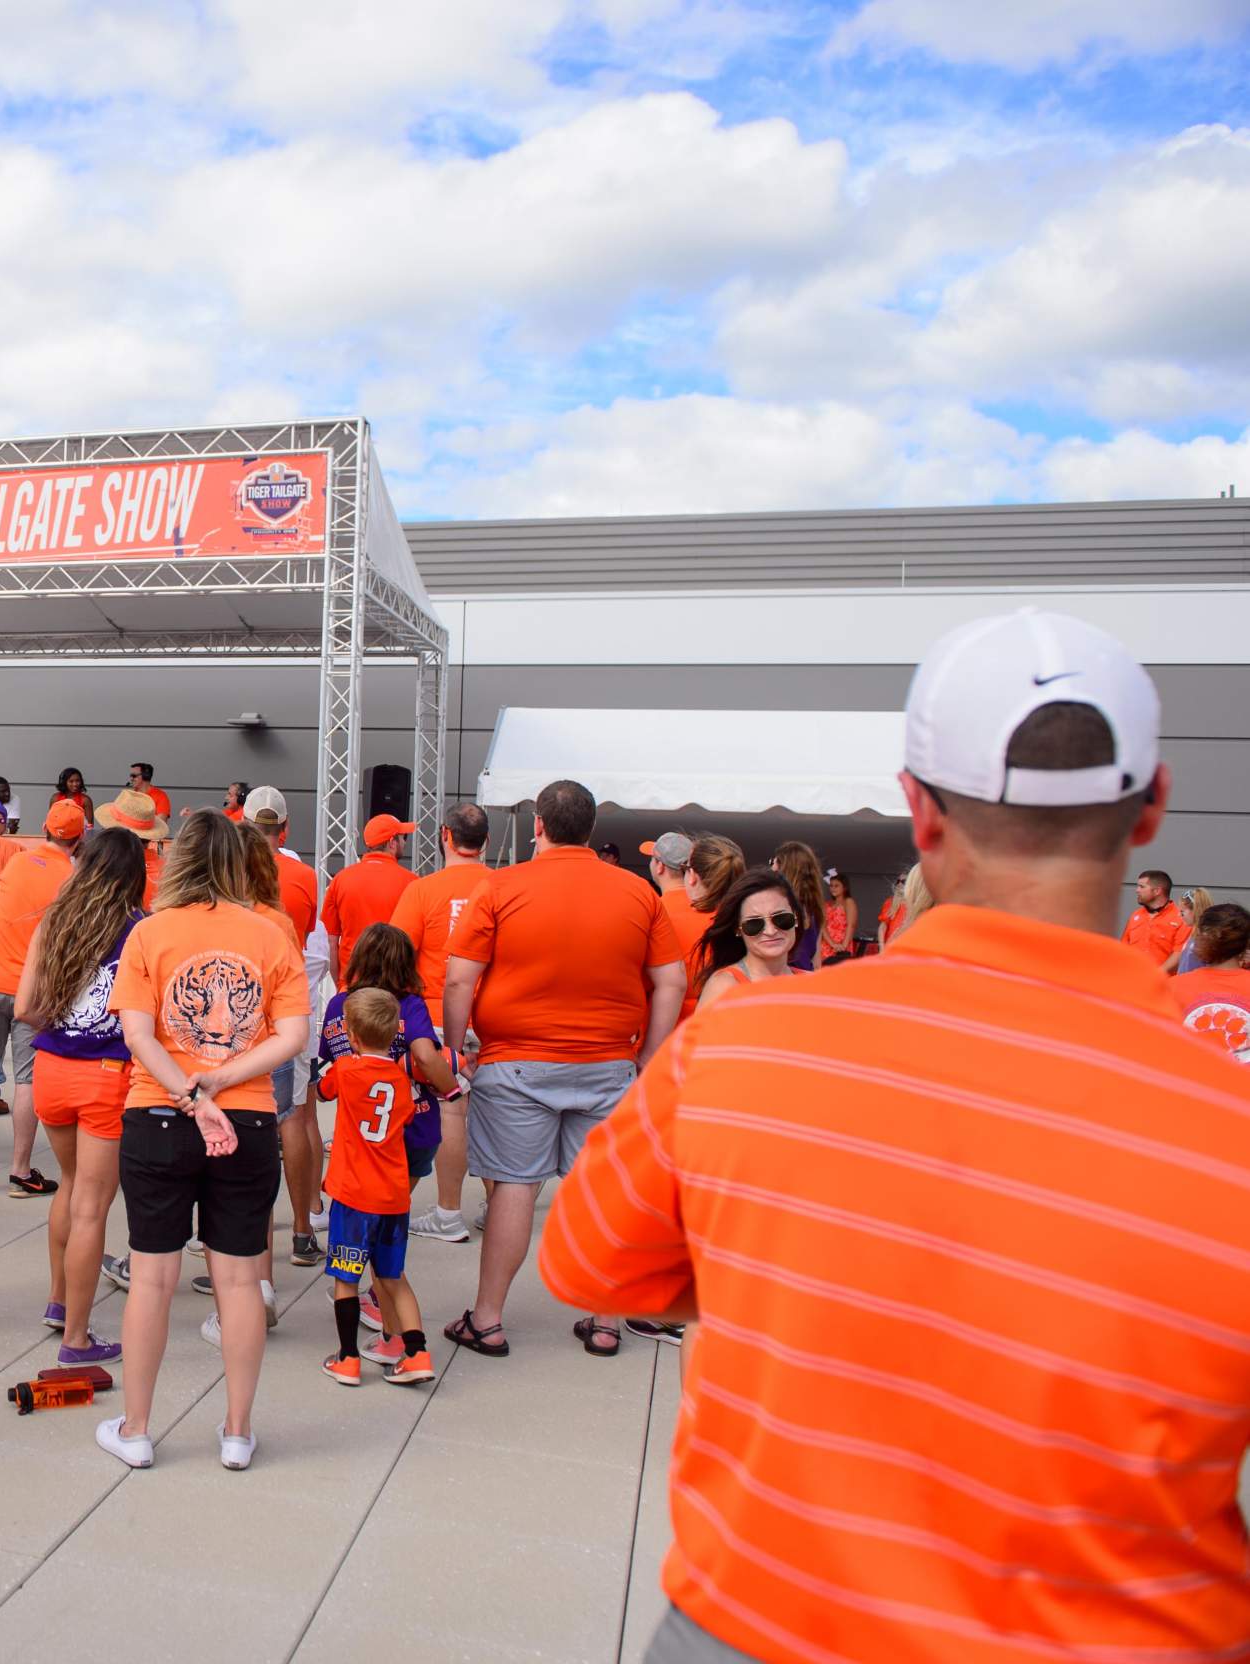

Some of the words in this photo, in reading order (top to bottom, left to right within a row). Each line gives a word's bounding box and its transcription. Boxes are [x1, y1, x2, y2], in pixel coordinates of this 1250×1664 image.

[94, 464, 205, 546] SHOW
[248, 486, 269, 498] TIGER
[270, 485, 306, 497] TAILGATE
[261, 500, 290, 508] SHOW
[359, 1081, 395, 1142] 3
